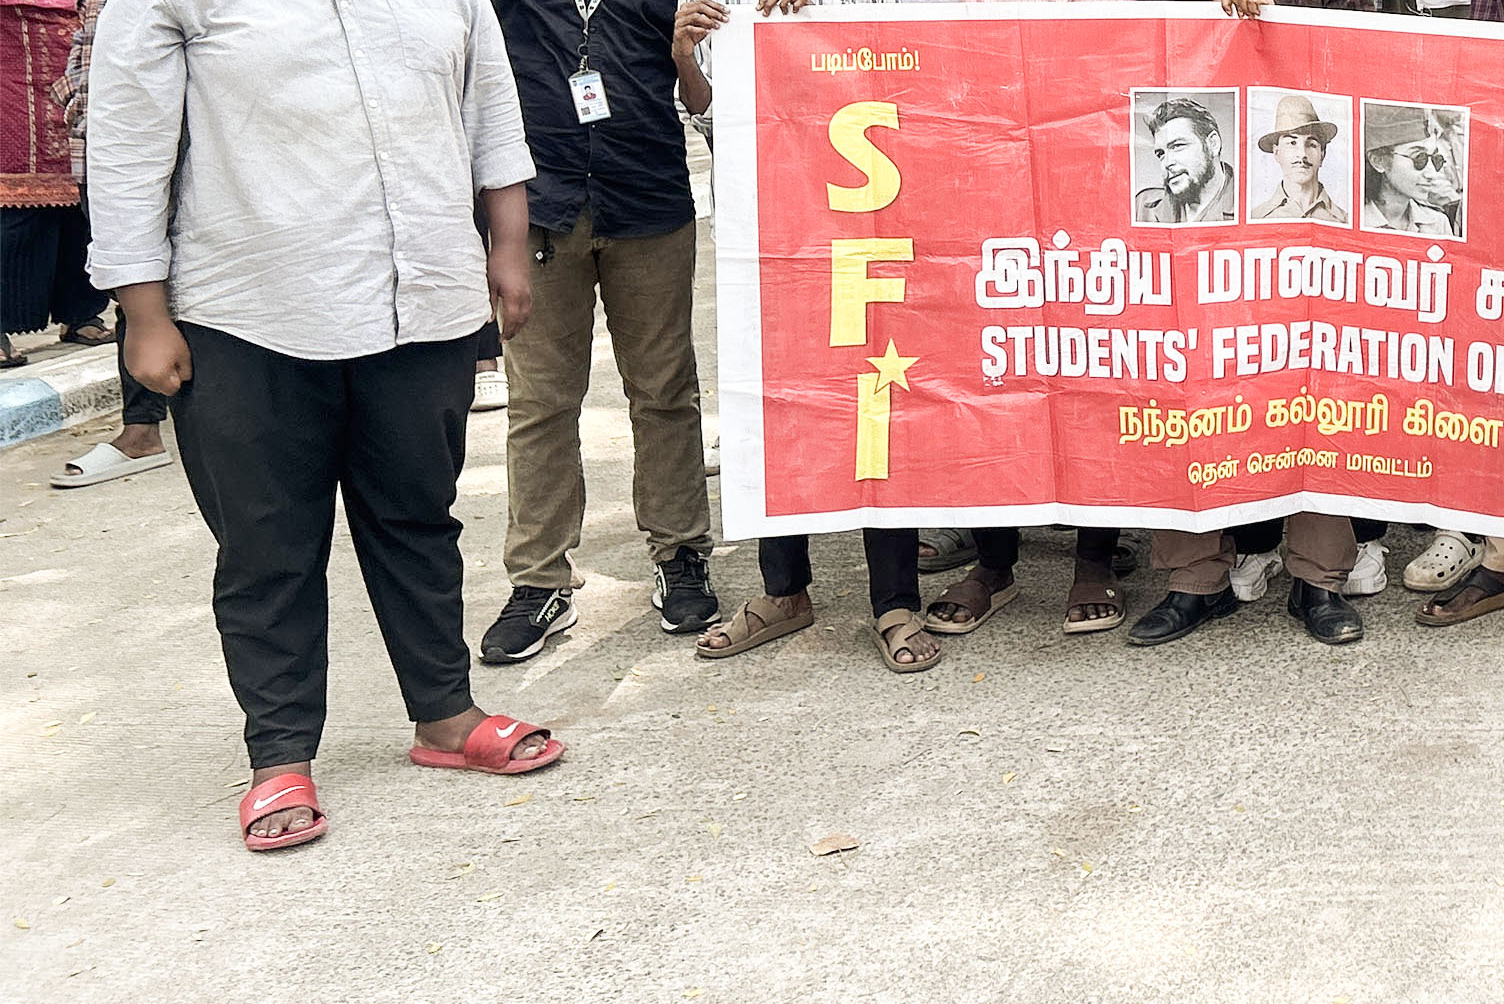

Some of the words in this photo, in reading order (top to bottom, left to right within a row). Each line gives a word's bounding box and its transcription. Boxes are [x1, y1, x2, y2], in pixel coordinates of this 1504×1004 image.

[811, 47, 921, 76] படிப்போம்!
[974, 229, 1173, 316] இந்திய
[1197, 244, 1453, 324] மாணவர்
[981, 325, 1199, 383] STUDENTS'
[1212, 320, 1456, 387] FEDERATION
[1119, 395, 1252, 448] நந்தனம்
[1265, 386, 1390, 436] கல்லூரி
[1402, 398, 1504, 447] கிளை
[1187, 455, 1240, 489] தென்
[1246, 446, 1339, 474] சென்னை
[1346, 453, 1433, 478] மாவட்டம்
